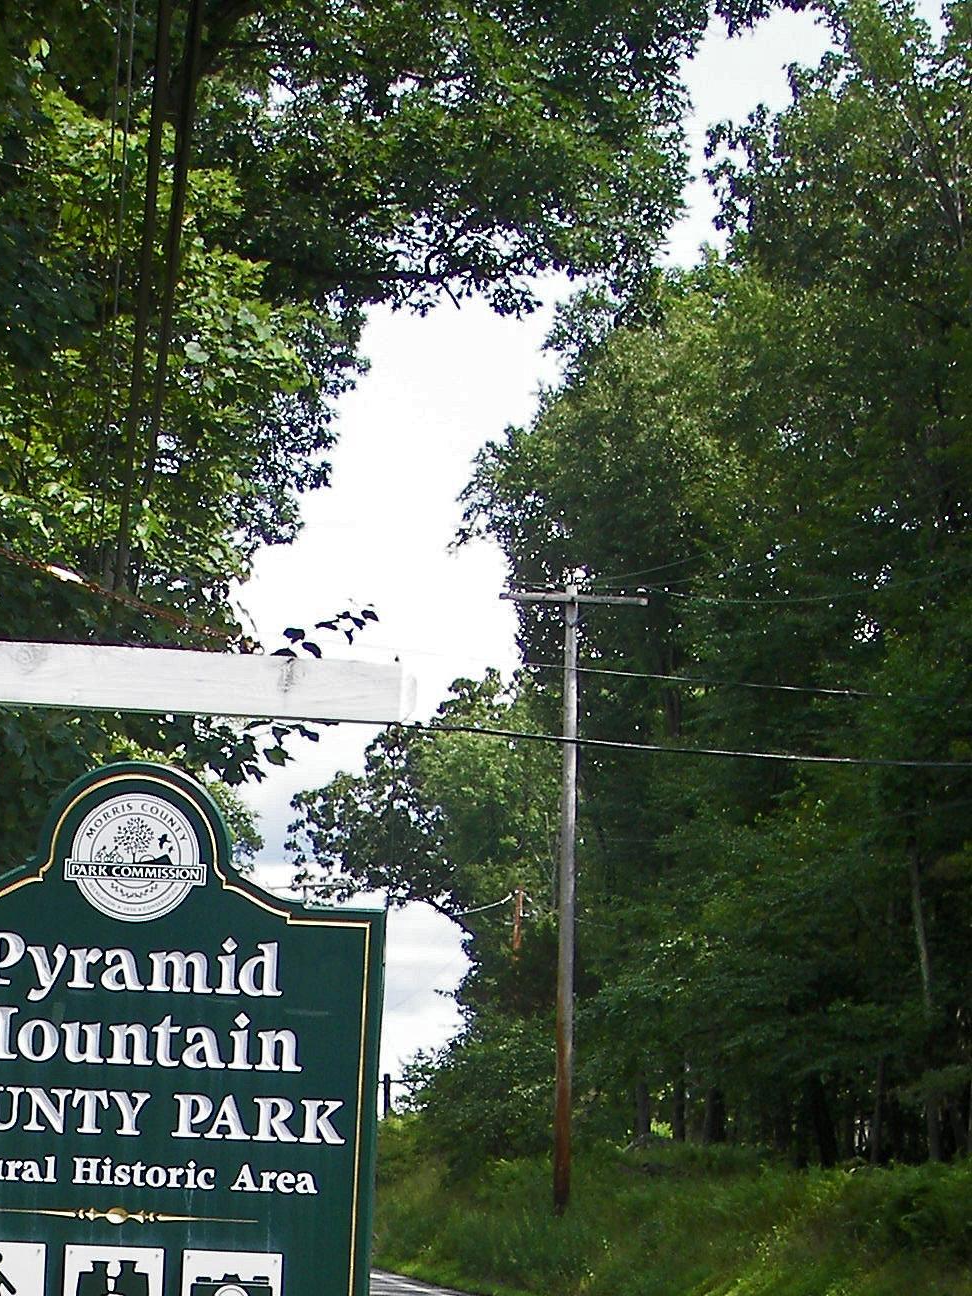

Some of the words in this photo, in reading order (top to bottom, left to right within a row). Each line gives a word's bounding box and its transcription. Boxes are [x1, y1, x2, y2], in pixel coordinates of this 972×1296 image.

[86, 803, 133, 839] MORRIS
[140, 803, 188, 842] COUNTY
[71, 864, 108, 877] PARK
[111, 867, 200, 881] COMMISSION
[171, 1094, 346, 1145] PARK
[72, 1157, 215, 1190] Historic
[230, 1165, 318, 1195] Area
